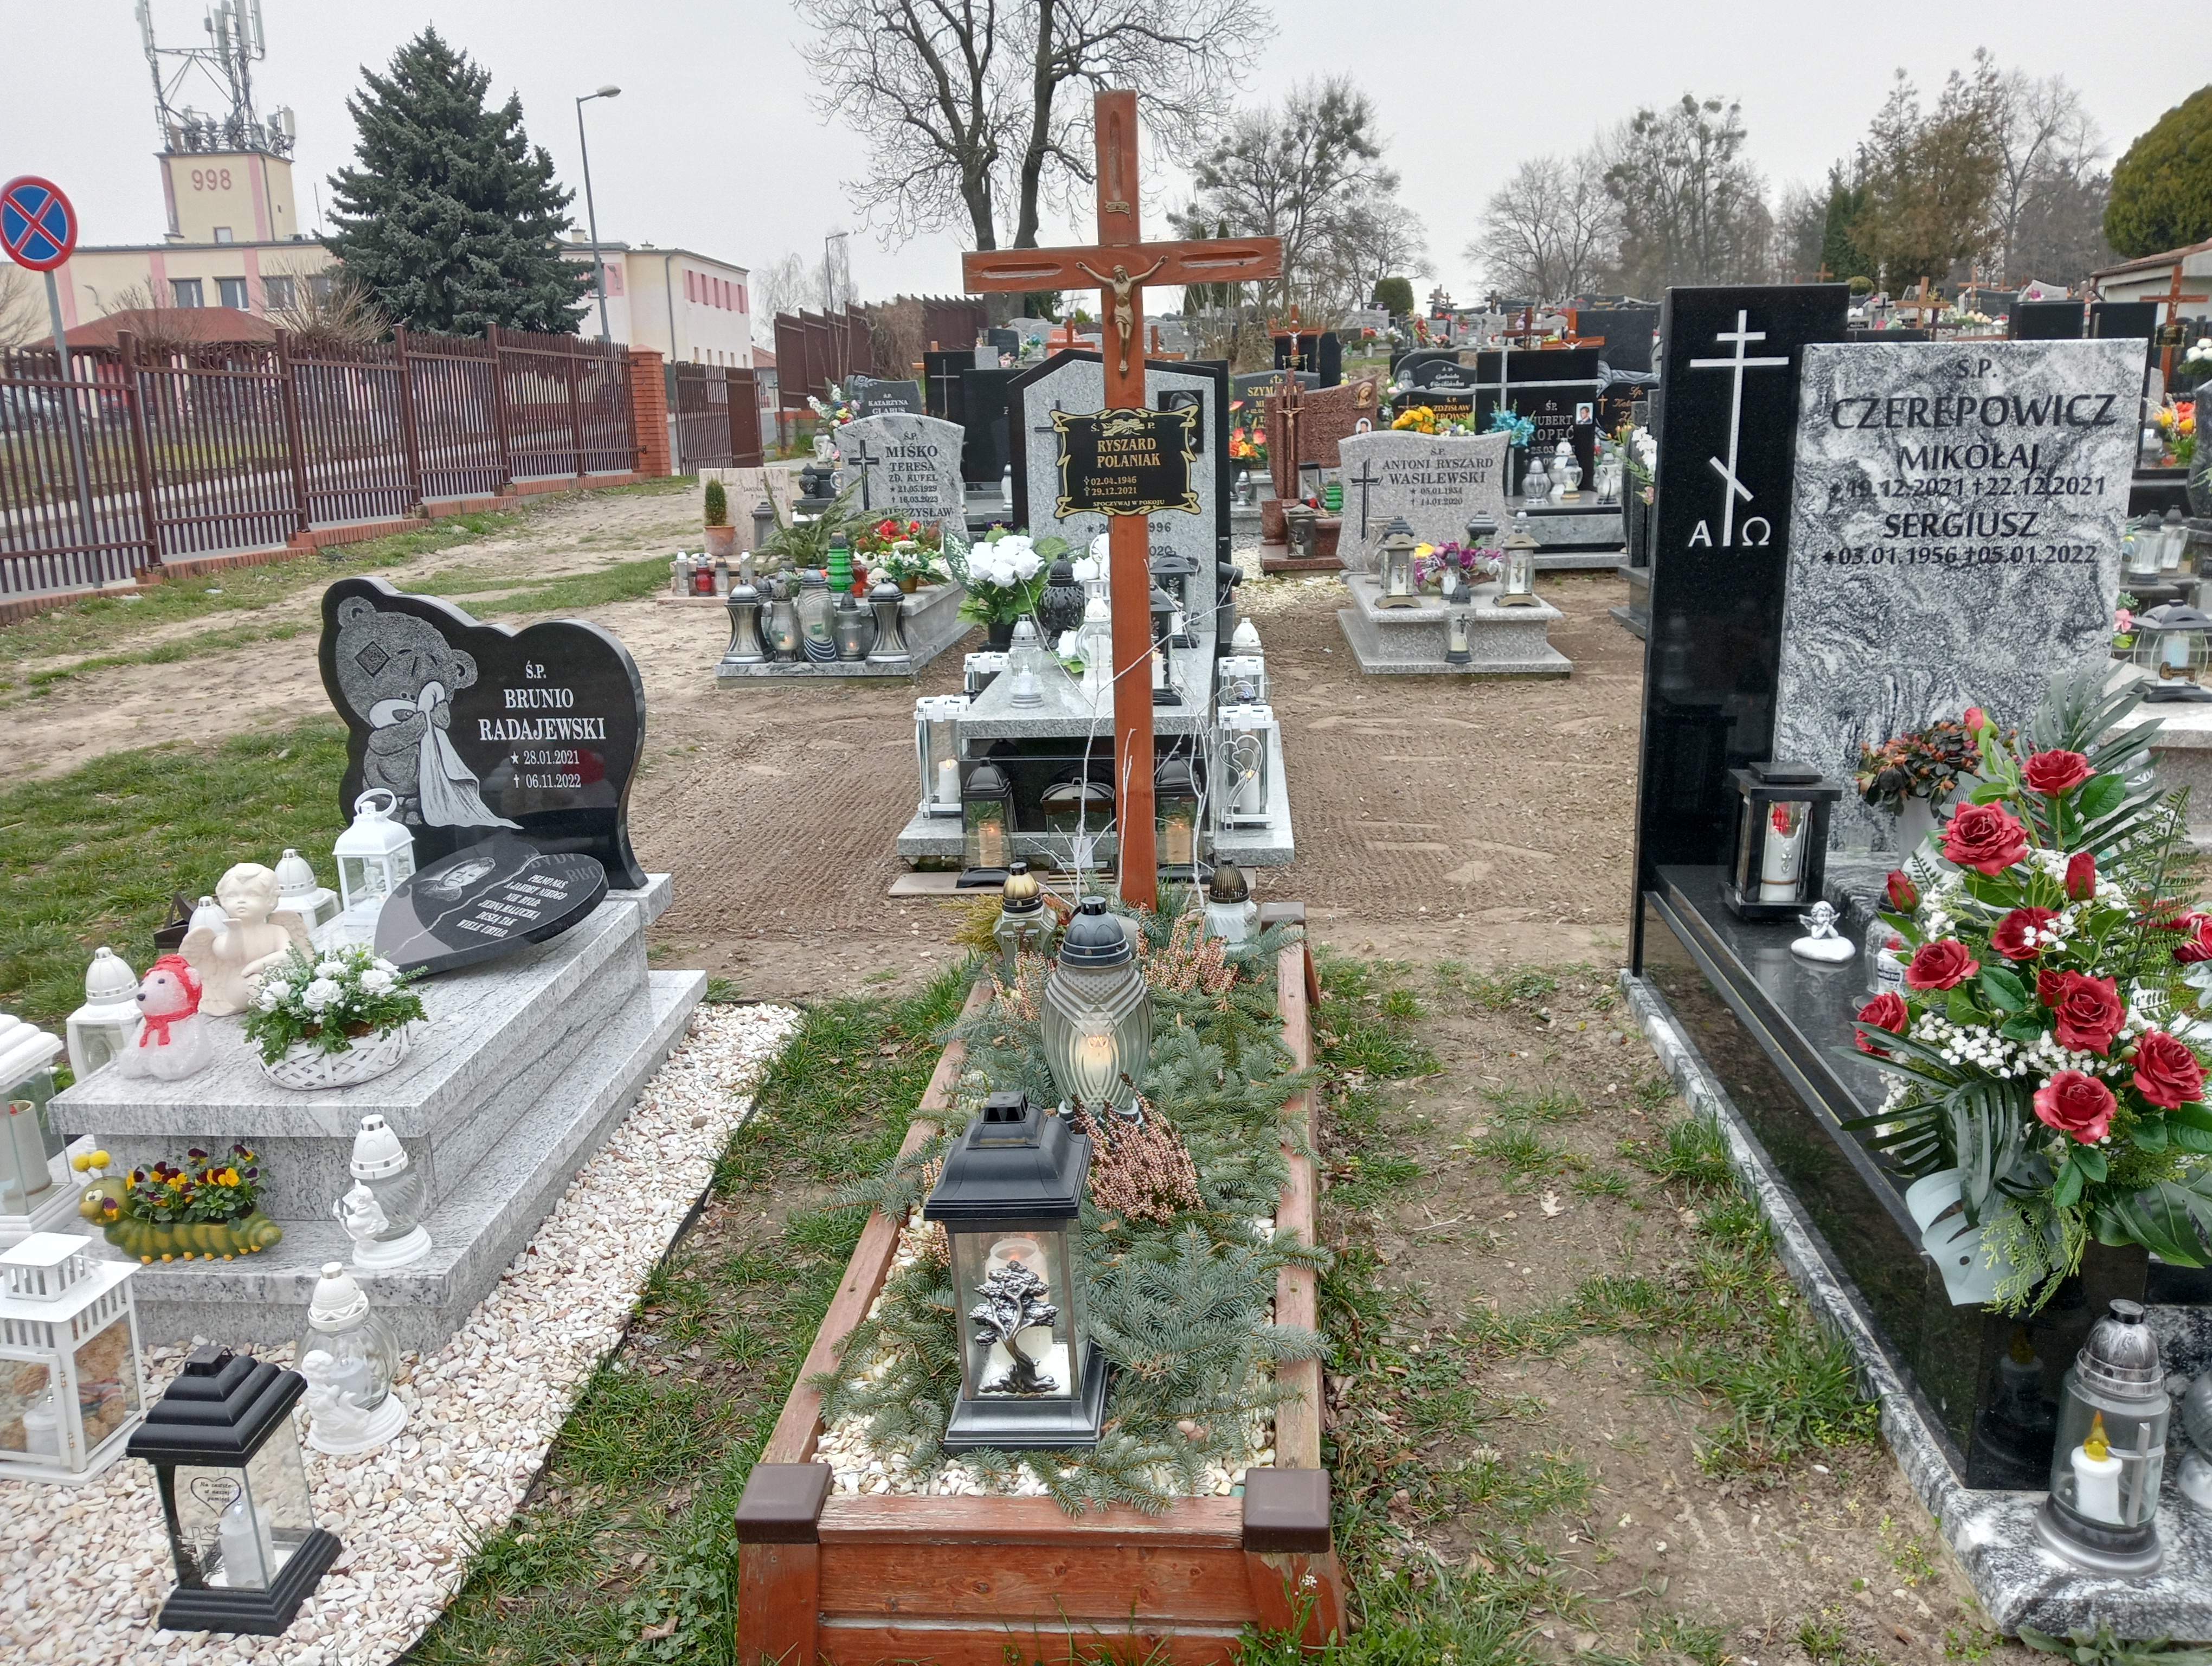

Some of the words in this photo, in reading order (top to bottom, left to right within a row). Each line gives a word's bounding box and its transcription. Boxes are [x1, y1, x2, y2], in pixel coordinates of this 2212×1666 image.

[191, 168, 232, 190] 998
[1831, 394, 2117, 430] CZEREPOWICZ
[885, 443, 938, 458] MIŚKO
[1097, 438, 1156, 452] RYSZARD
[890, 462, 936, 472] TERESA
[1097, 453, 1161, 468] POLANIAK
[1382, 459, 1430, 470] ANTONI
[1436, 458, 1494, 469] RYSZARD
[1091, 476, 1137, 485] 02.04.1946
[1389, 471, 1487, 485] WASILEWSKI
[1091, 486, 1137, 496] 29.12.2021
[1883, 511, 2040, 538] SERGIUSZ
[1838, 546, 1958, 565] 03.01.1956
[1977, 545, 2098, 565] 05.01.2022
[525, 660, 546, 678] Ś.P.
[503, 688, 574, 709] BRUNIO
[478, 717, 607, 741] RADAJEWSKI
[523, 750, 580, 765] 28.01.2021
[525, 773, 582, 788] 06.11.2022
[503, 893, 522, 901] NIE
[536, 888, 568, 900] NIKOGO
[456, 919, 485, 931] WIELE
[498, 917, 518, 926] TAK
